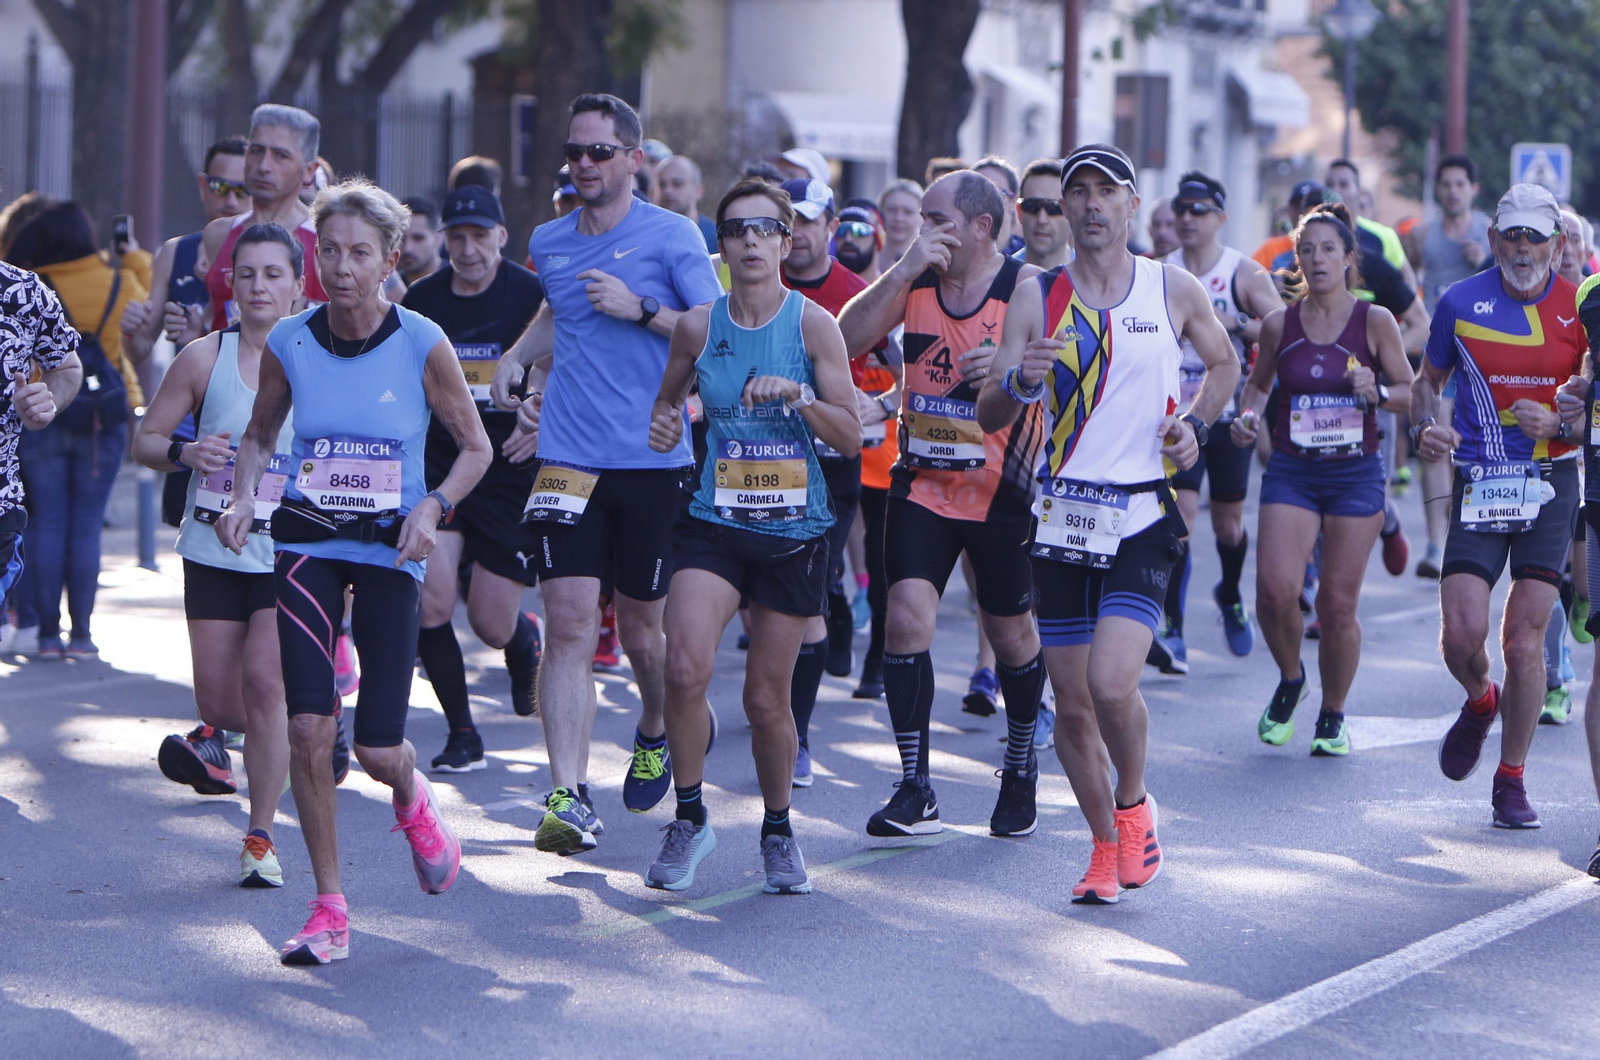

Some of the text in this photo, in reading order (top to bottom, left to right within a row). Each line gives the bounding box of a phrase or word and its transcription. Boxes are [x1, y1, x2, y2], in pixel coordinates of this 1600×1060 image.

[931, 346, 953, 375] 4
[929, 369, 951, 385] Km
[928, 400, 974, 417] ZURICH
[1314, 418, 1342, 429] 8348
[927, 427, 957, 441] 4233
[1311, 433, 1345, 443] CONNOR
[333, 442, 390, 456] ZURICH
[744, 445, 794, 457] ZURICH
[928, 445, 955, 456] JORDI
[329, 473, 370, 489] 8458
[539, 478, 568, 491] 5305
[744, 474, 779, 487] 6198
[534, 495, 560, 506] OLIVER
[737, 493, 784, 505] CARMELA
[1481, 488, 1519, 500] 13424
[320, 494, 376, 508] CATARINA
[1478, 508, 1522, 519] E. RANGEL
[1065, 513, 1096, 530] 9316
[1066, 533, 1087, 547] IVÁN
